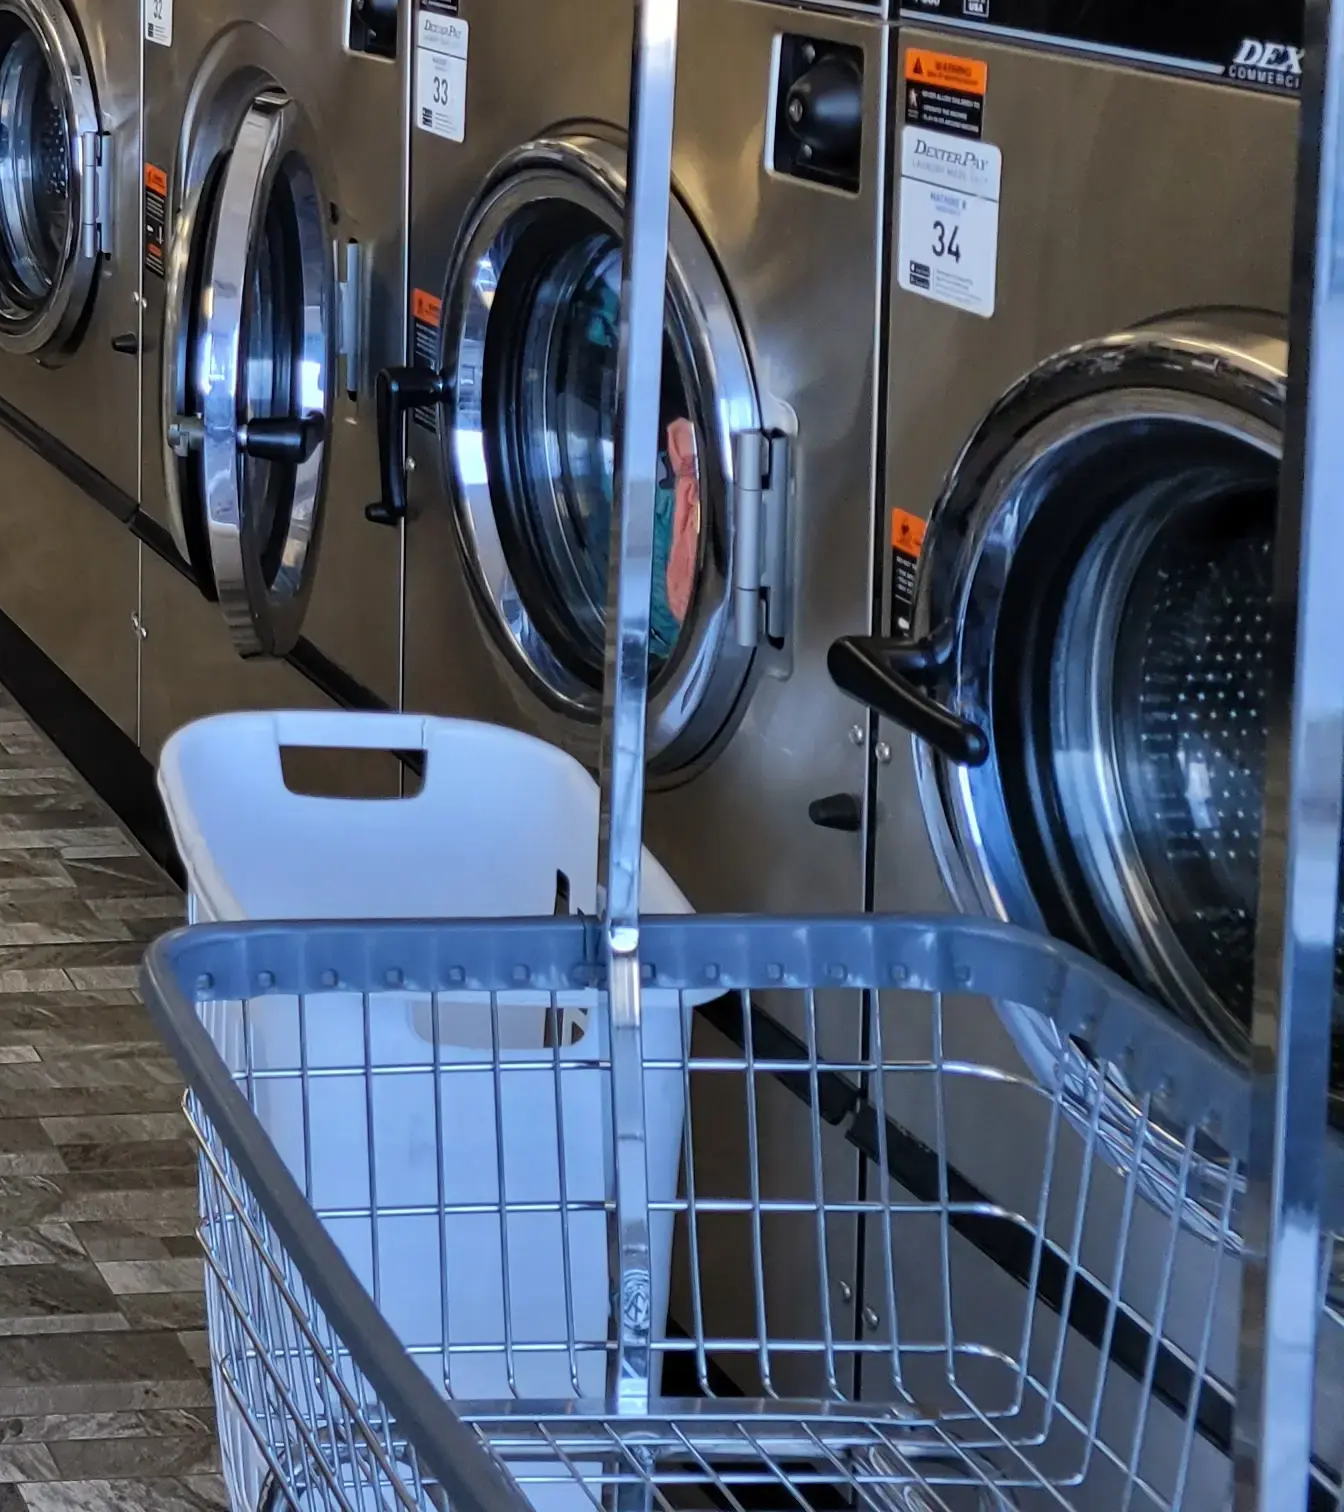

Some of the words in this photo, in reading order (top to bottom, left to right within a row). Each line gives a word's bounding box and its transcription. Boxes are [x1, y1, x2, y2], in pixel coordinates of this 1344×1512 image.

[968, 1, 984, 13] USA
[432, 76, 449, 106] 33
[931, 220, 961, 265] 34
